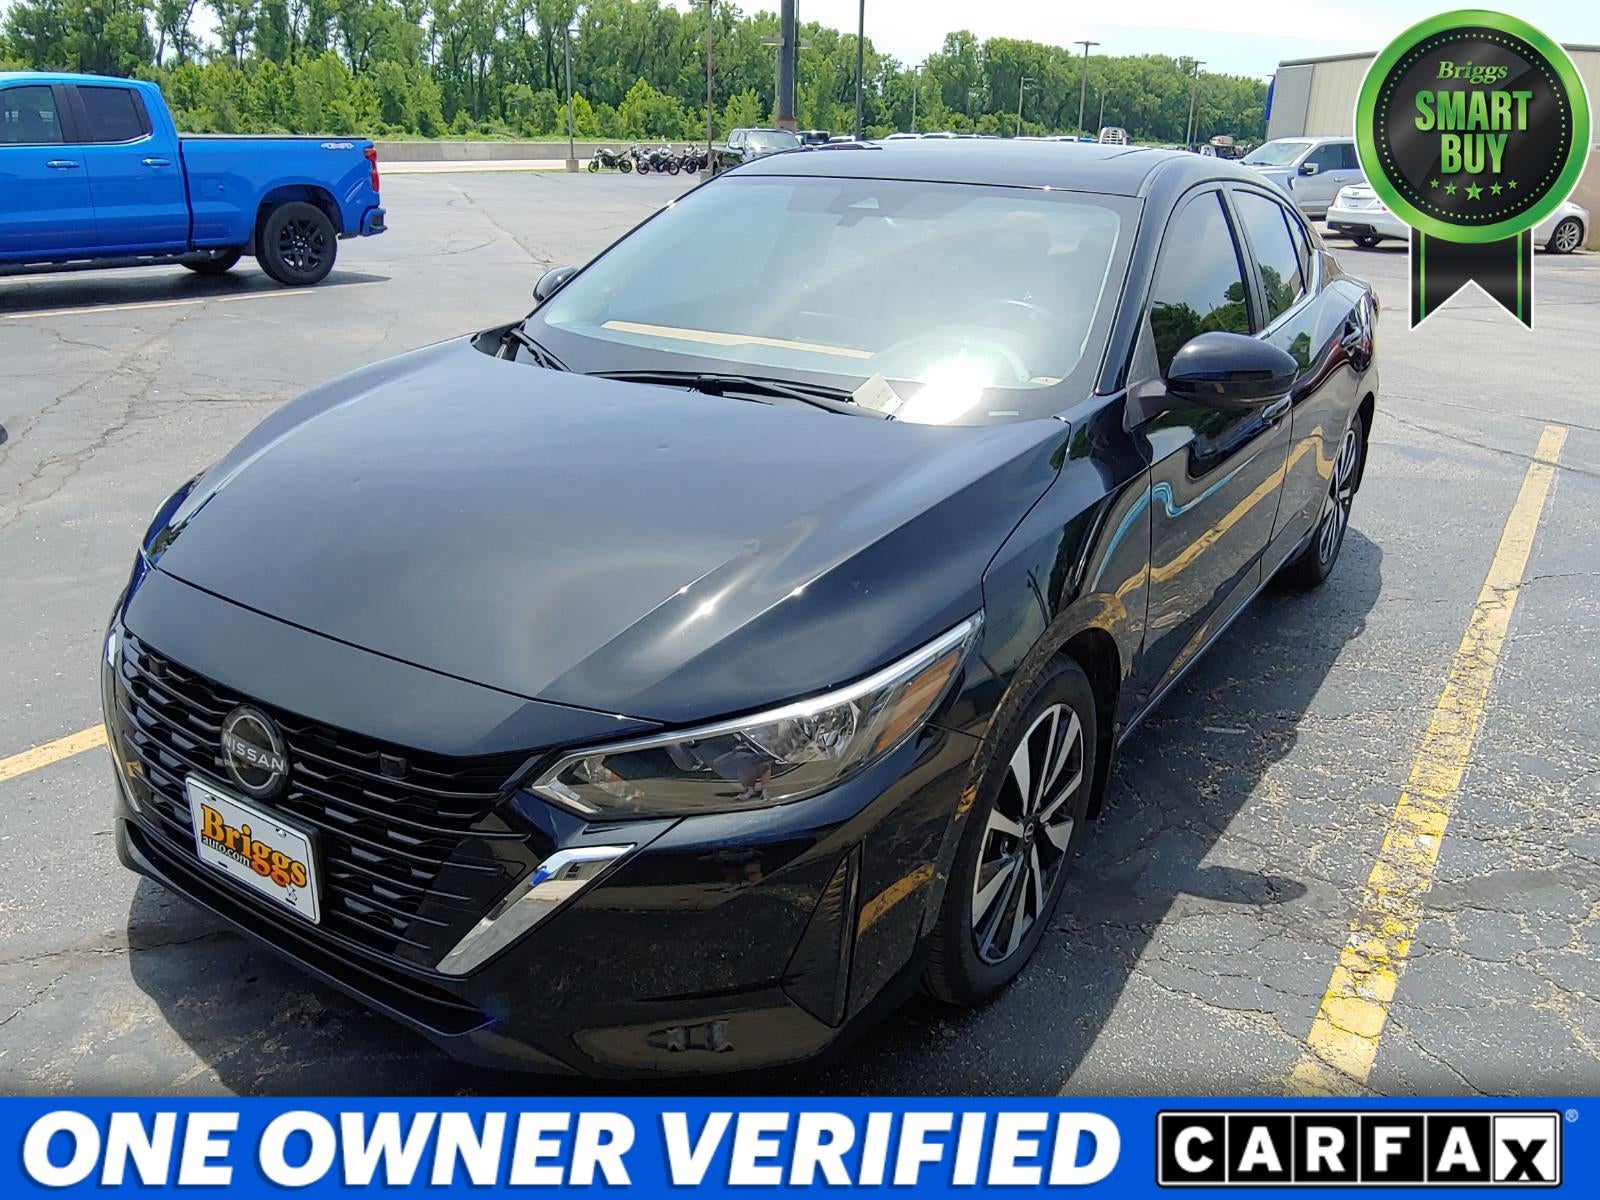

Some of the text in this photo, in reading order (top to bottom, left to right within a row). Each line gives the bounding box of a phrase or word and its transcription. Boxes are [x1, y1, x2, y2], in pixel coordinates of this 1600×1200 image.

[223, 734, 285, 772] NISSAN
[201, 802, 307, 888] Briggs
[202, 834, 251, 868] auto.com
